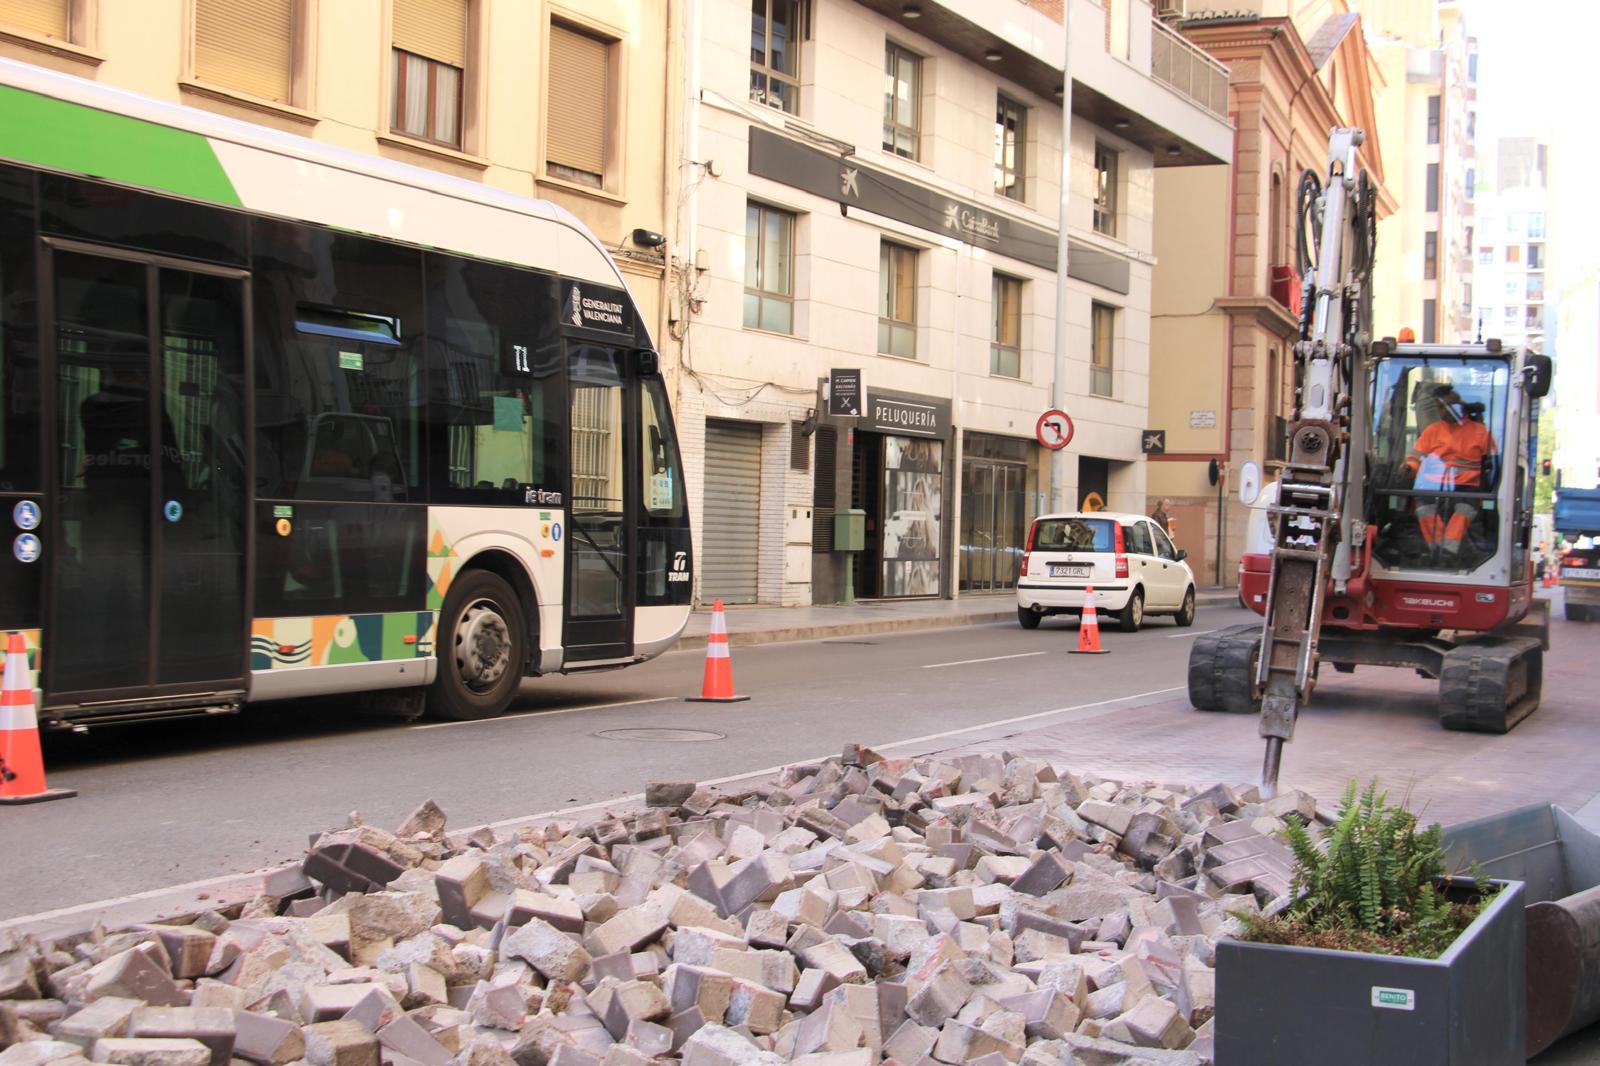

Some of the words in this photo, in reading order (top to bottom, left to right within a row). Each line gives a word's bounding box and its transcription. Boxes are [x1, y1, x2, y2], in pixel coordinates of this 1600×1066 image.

[582, 298, 623, 313] GENERALITAT
[583, 309, 623, 325] VALENCIANA
[876, 406, 936, 427] PELUQUERÍA
[668, 571, 690, 582] TRAM
[1380, 992, 1407, 1002] BENITO
